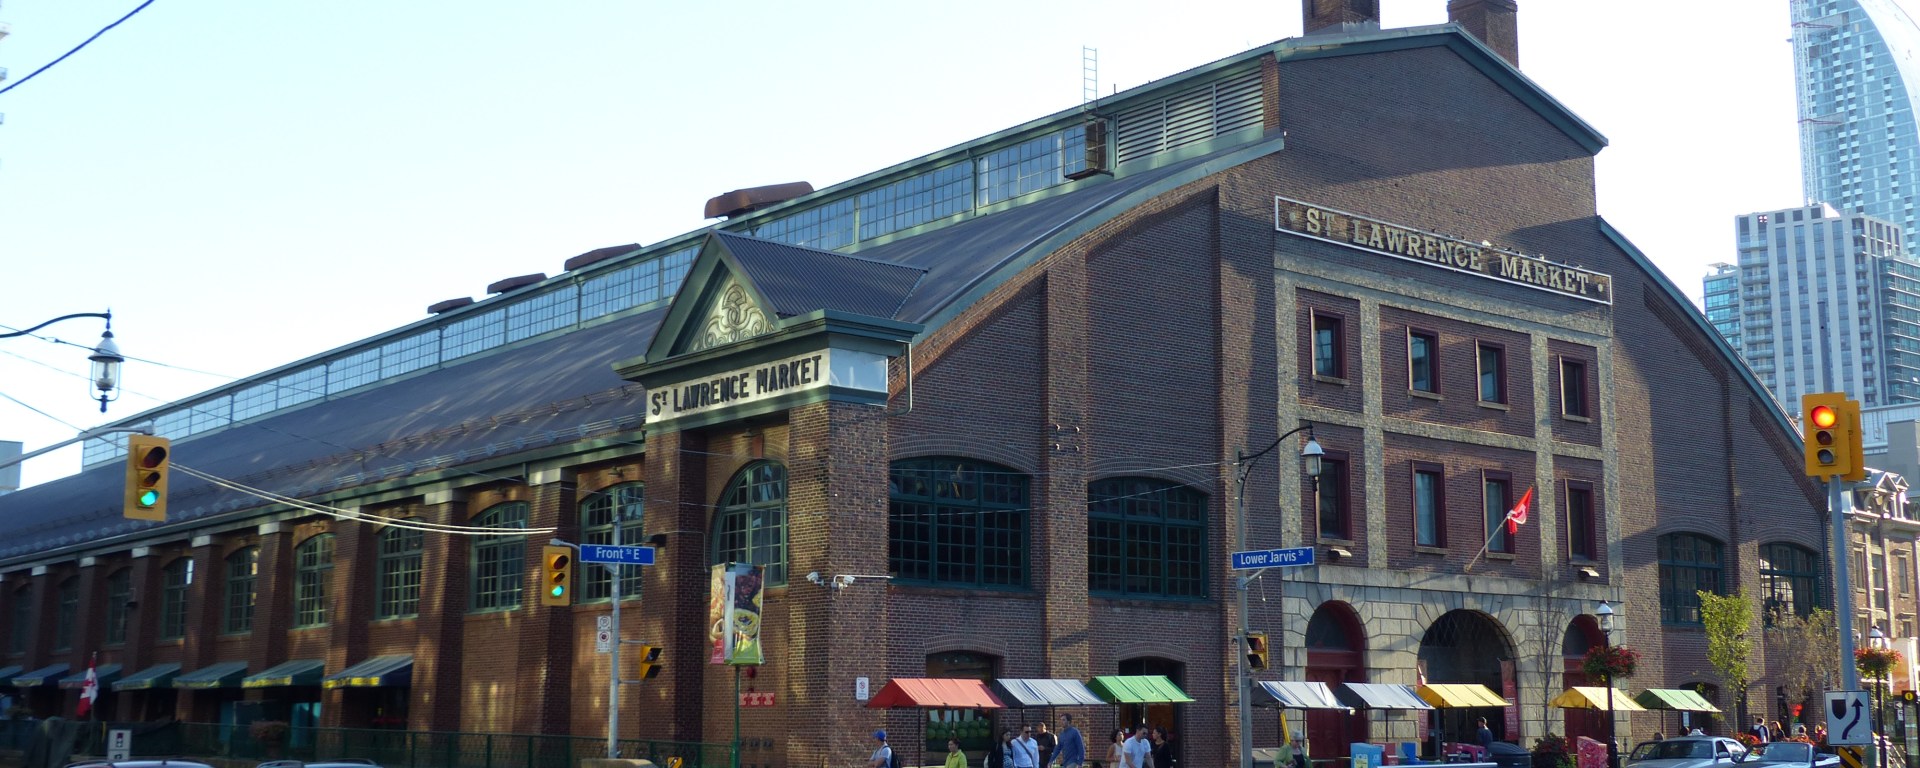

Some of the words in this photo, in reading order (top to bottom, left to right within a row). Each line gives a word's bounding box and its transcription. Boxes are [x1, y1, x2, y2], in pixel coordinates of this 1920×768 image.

[1352, 219, 1483, 271] LAWRENCE
[1500, 253, 1590, 295] MARKET
[673, 372, 750, 412] LAWRENCE
[756, 355, 822, 395] MARKET
[596, 547, 624, 560] Front
[633, 549, 640, 560] E
[1240, 554, 1267, 565] Lower
[1269, 550, 1297, 563] Jarvis
